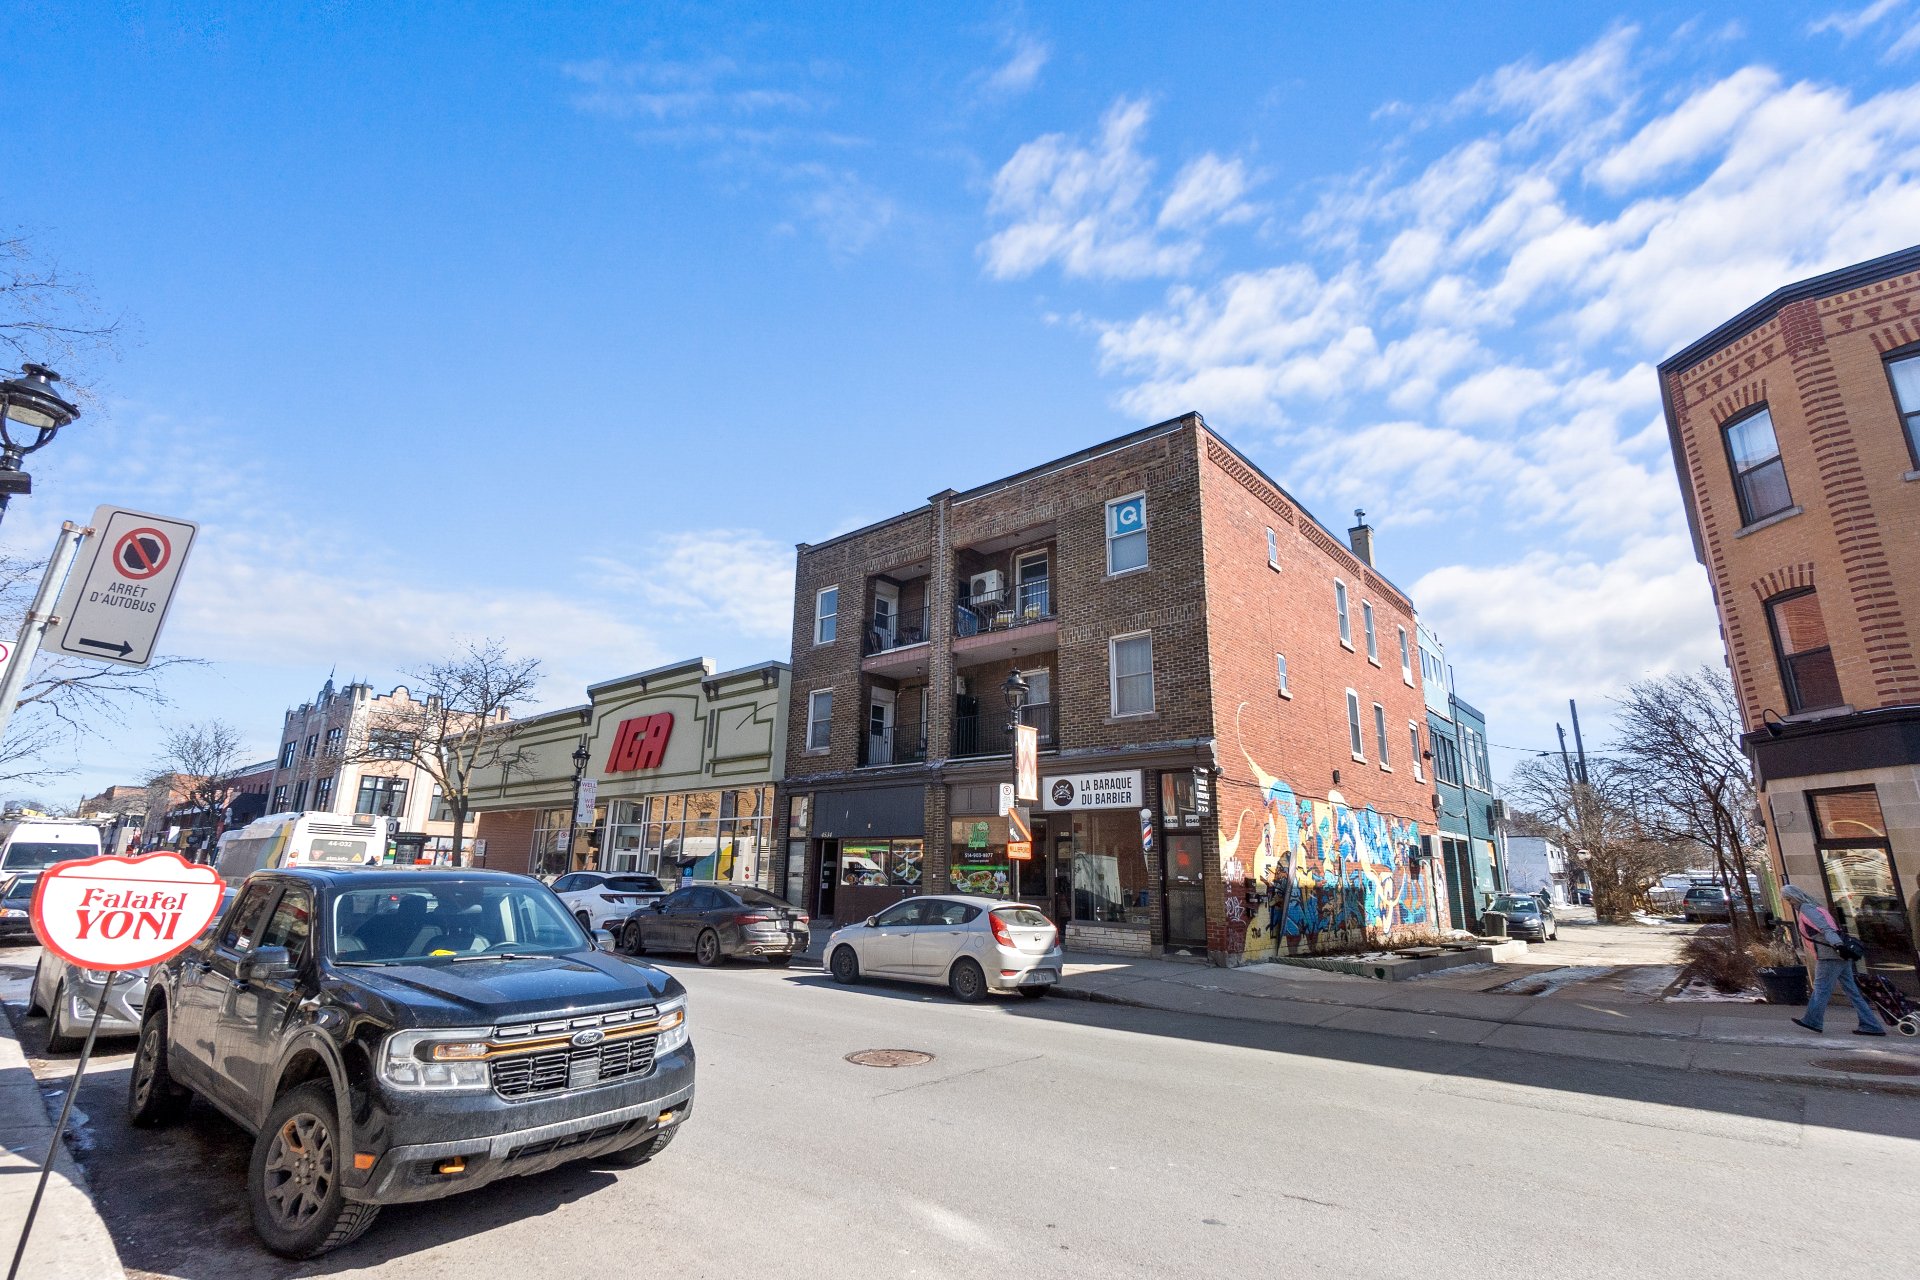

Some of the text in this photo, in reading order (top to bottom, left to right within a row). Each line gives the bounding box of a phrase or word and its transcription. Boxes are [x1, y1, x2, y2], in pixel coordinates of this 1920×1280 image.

[90, 591, 156, 613] D'AUTOBUS
[604, 712, 675, 774] IGA
[1080, 777, 1132, 791] LA BARAQUE
[1081, 791, 1132, 805] DU BARBIER
[79, 888, 189, 910] Falafel
[75, 909, 182, 939] YONI
[581, 1032, 599, 1044] Ford
